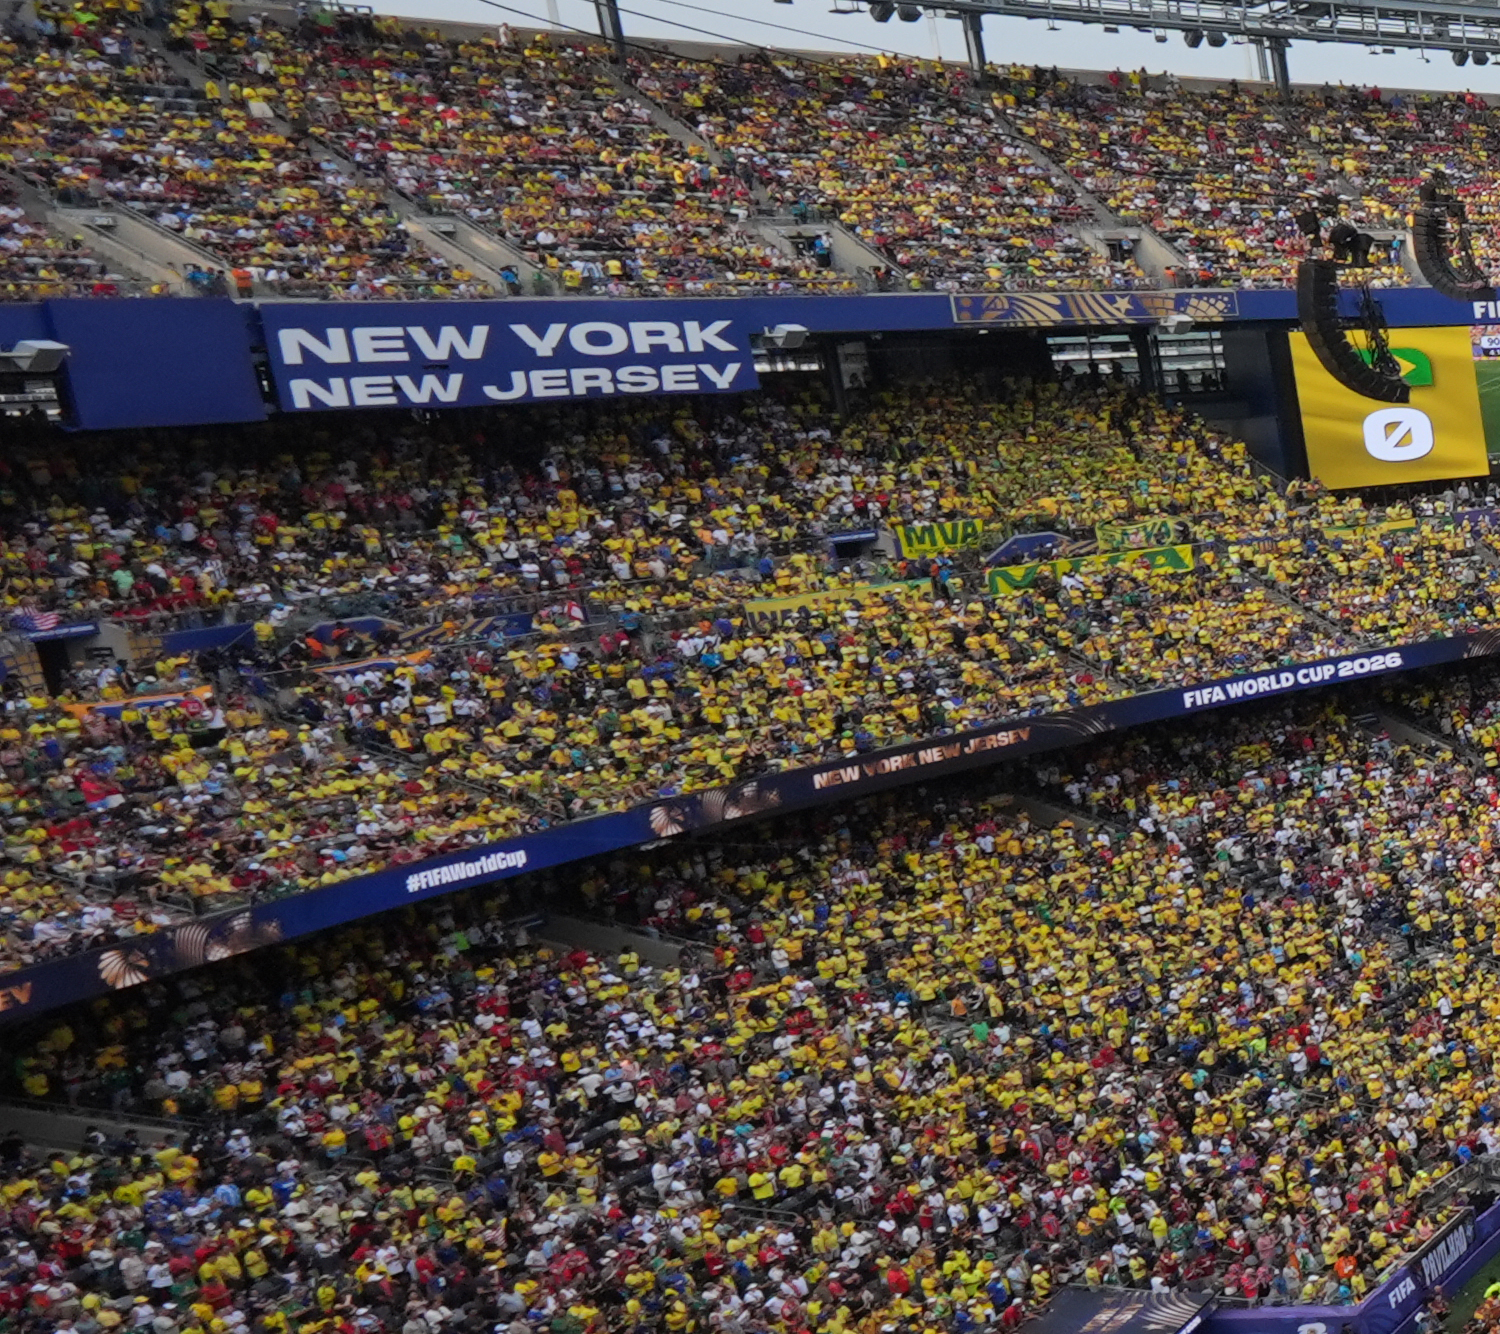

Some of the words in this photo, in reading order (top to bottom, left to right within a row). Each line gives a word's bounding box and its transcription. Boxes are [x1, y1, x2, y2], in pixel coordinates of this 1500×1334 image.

[278, 326, 489, 366] NEW
[510, 319, 740, 358] YORK
[288, 373, 463, 410] NEW
[482, 362, 741, 402] JERSEY
[1362, 407, 1435, 462] 0
[1183, 686, 1227, 709] FIFA
[1226, 671, 1295, 699] WORLD
[1297, 664, 1337, 686] CUP
[1337, 652, 1402, 678] 2026
[813, 764, 861, 790] NEW
[862, 754, 918, 780] YORK
[918, 742, 961, 766] NEW
[963, 726, 1032, 754] JERSEY
[406, 850, 528, 893] #FIFAWorldCup
[1388, 1275, 1416, 1309] FIFA
